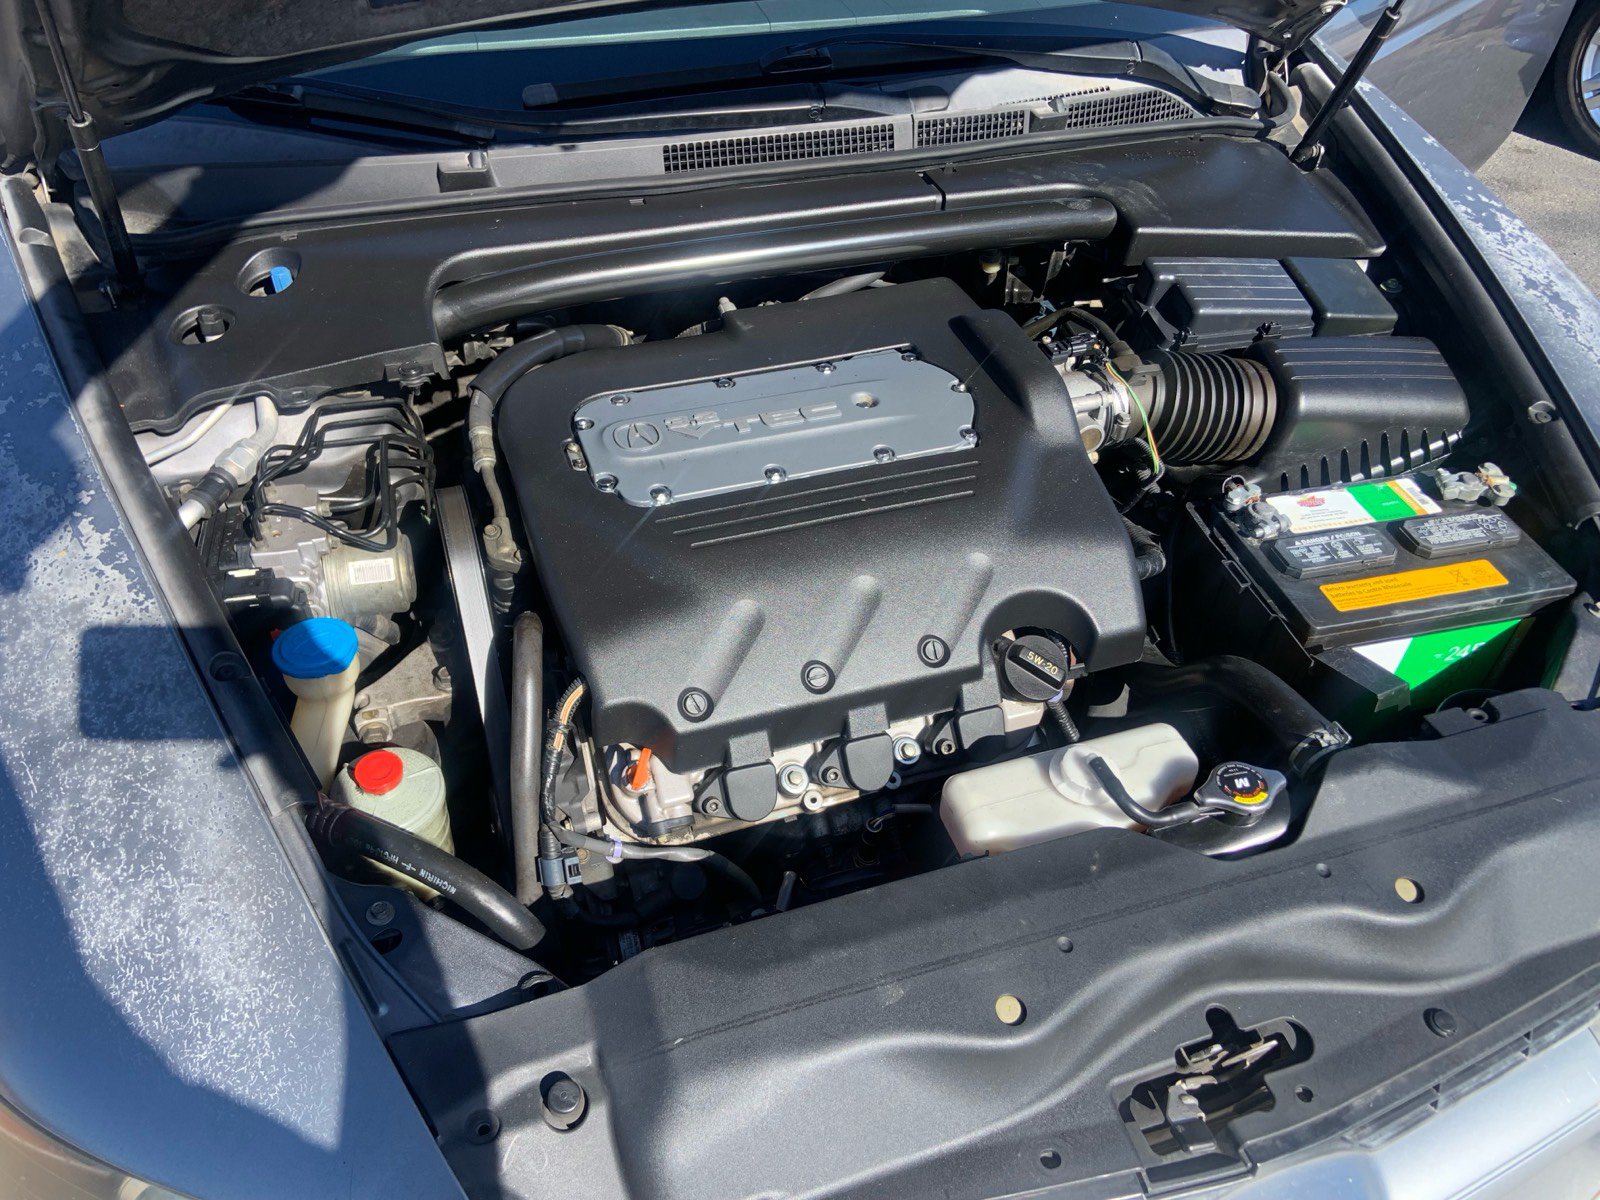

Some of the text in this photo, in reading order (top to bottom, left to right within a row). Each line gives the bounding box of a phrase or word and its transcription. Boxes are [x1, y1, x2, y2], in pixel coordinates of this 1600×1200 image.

[667, 402, 842, 440] VTEC
[1302, 536, 1331, 545] DANGER
[1335, 531, 1361, 539] POISON
[1027, 651, 1058, 675] 5W-20
[419, 868, 457, 895] NICHIRIN
